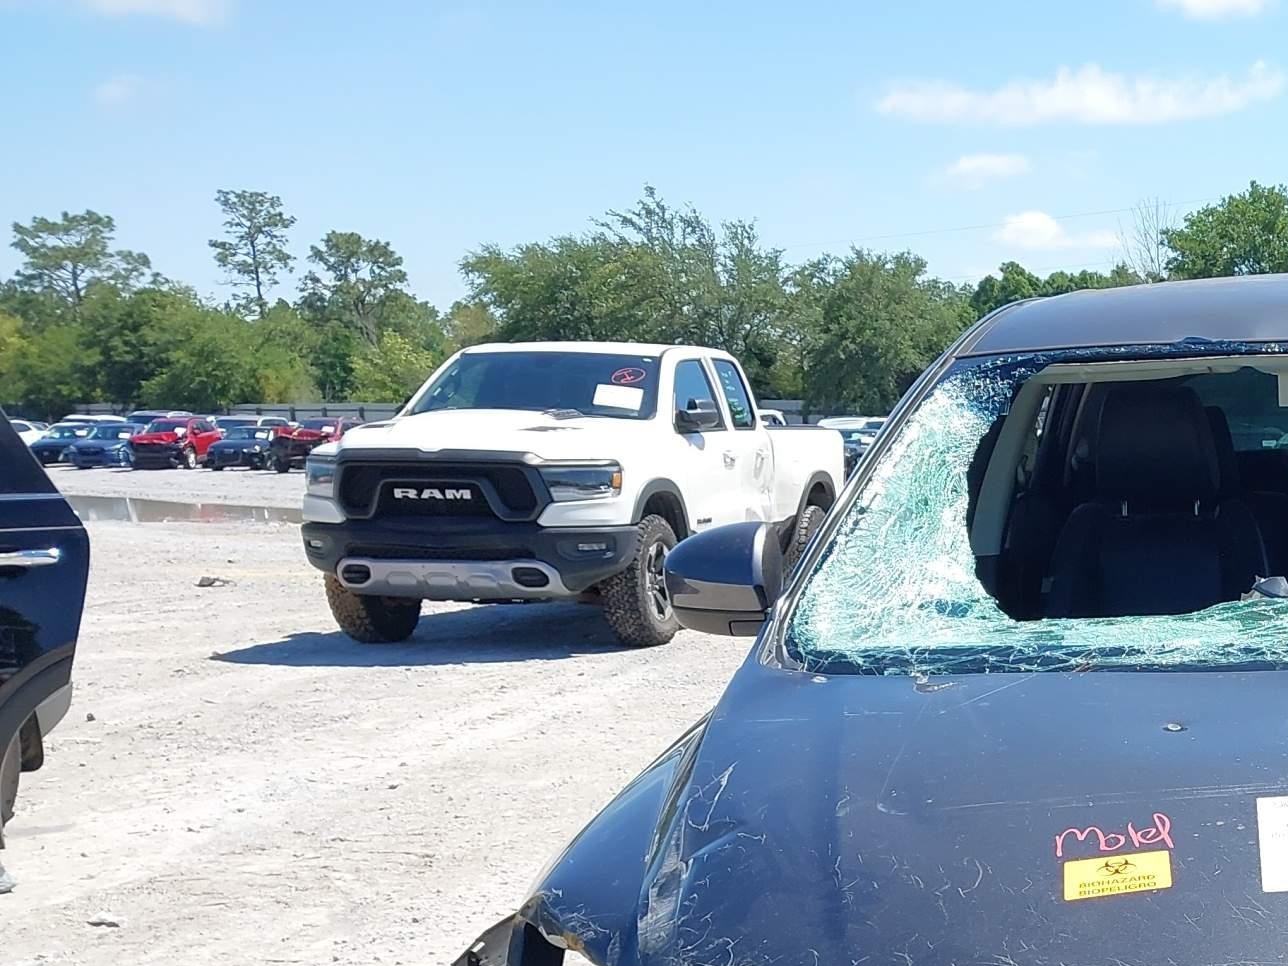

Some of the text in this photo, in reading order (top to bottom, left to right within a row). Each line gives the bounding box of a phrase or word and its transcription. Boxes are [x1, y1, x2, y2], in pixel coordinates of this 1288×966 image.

[393, 487, 472, 499] RAM
[1079, 874, 1156, 889] BIOHAZARD
[1079, 881, 1157, 896] BIOPELIGRO
